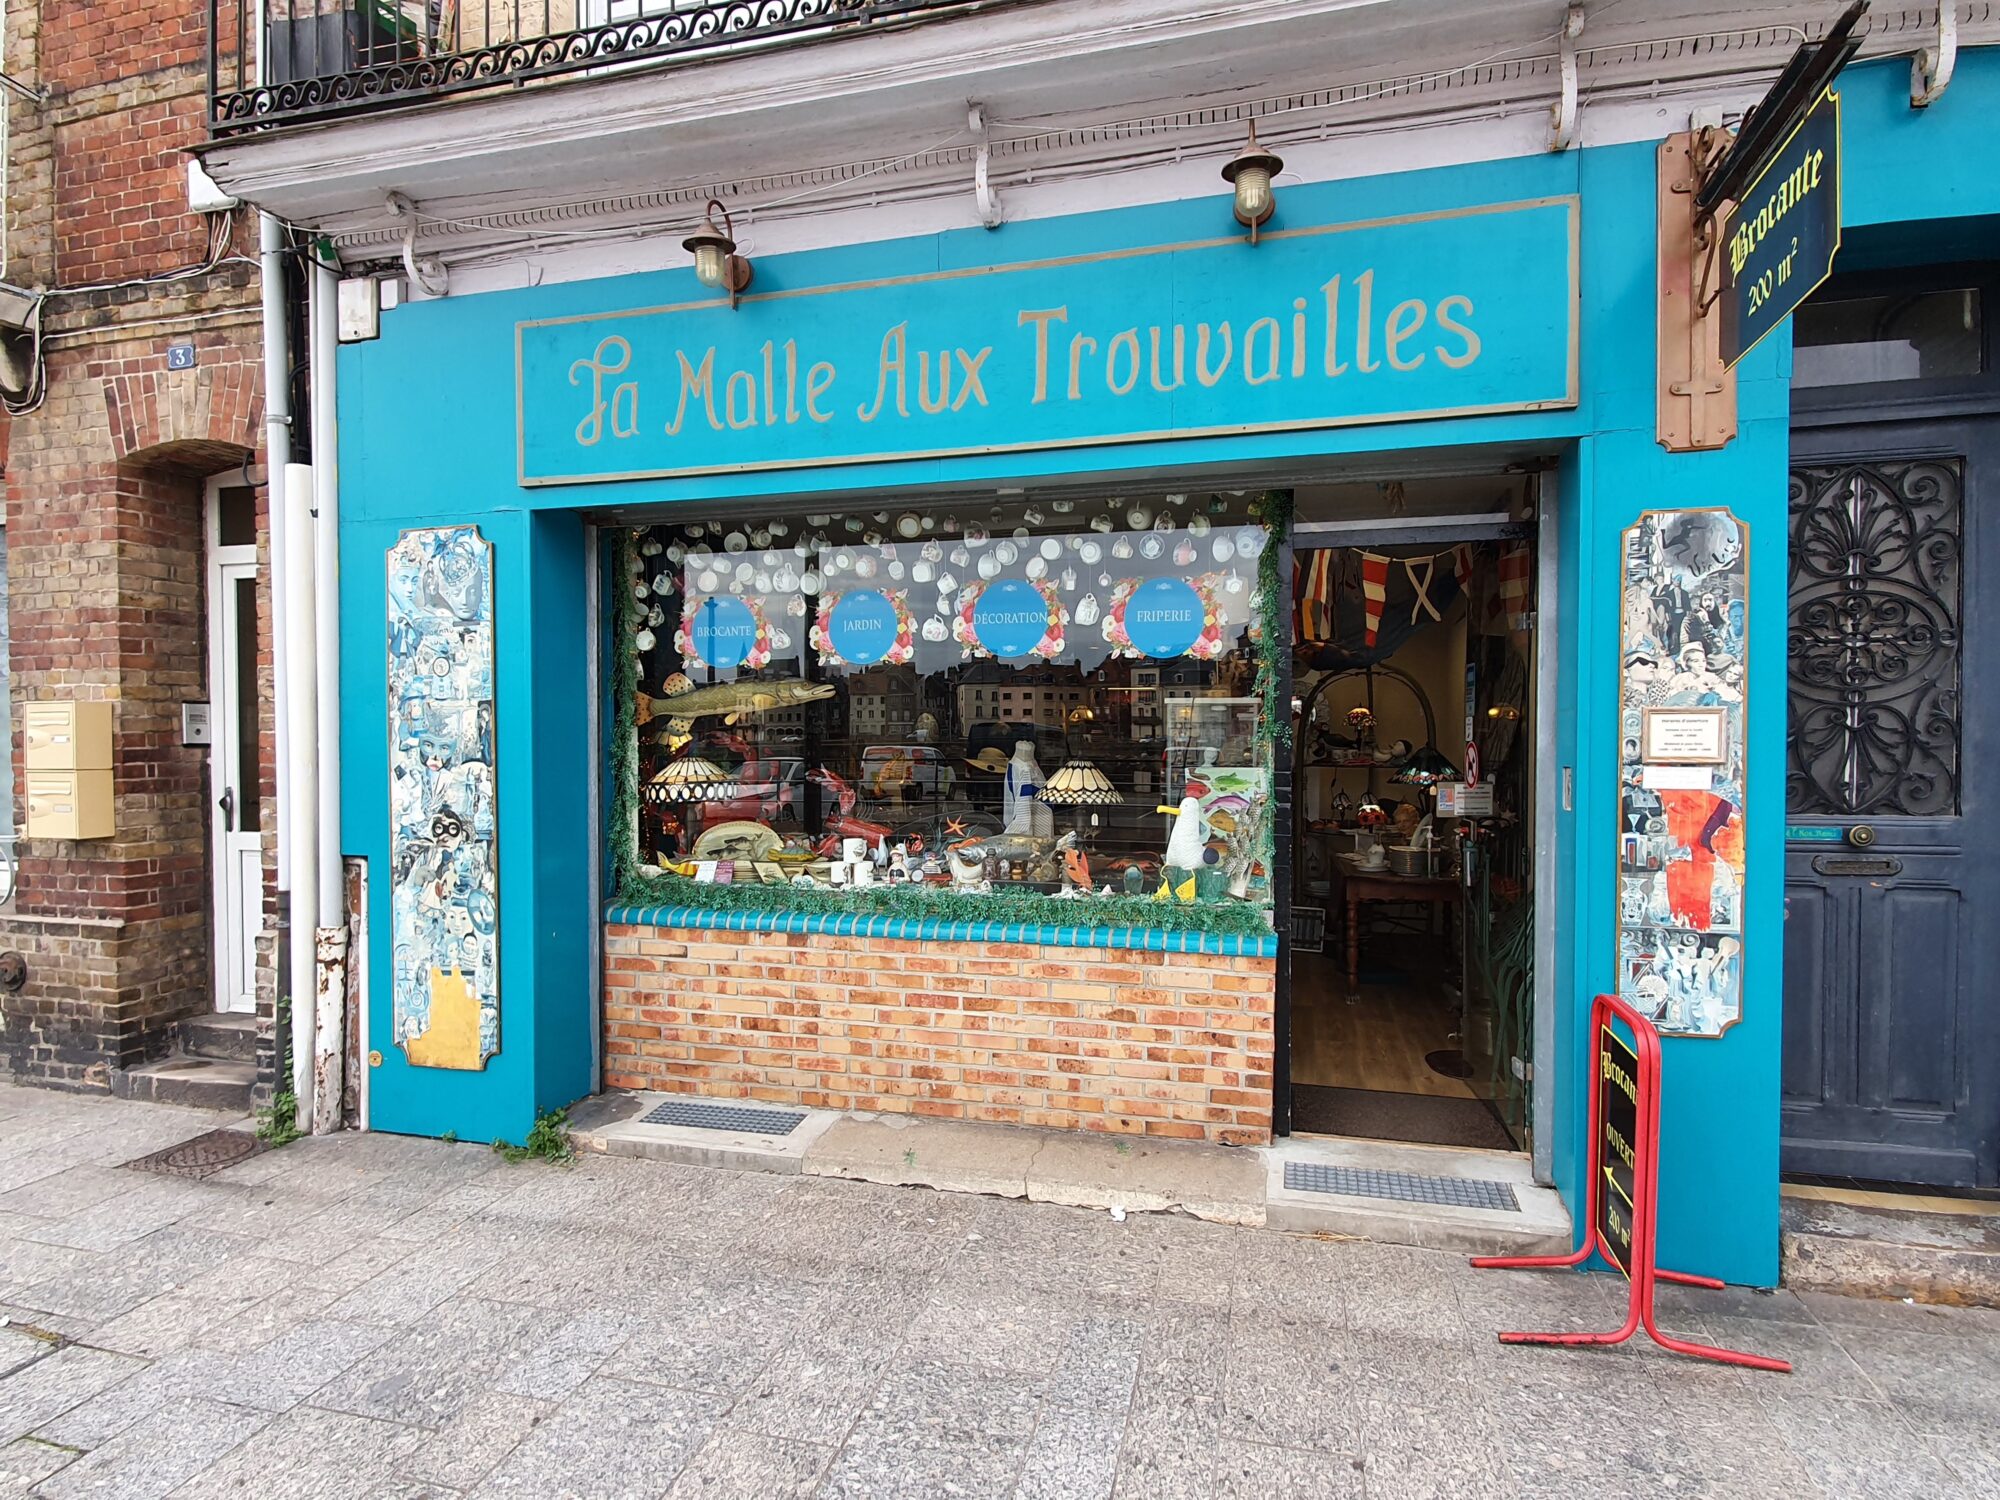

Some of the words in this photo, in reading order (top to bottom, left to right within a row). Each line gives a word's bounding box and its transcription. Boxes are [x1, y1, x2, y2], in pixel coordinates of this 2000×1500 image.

[1729, 148, 1824, 288] Brocante
[1748, 269, 1772, 317] 200
[175, 348, 186, 366] 3
[568, 334, 641, 447] La
[664, 337, 837, 436] Malle
[856, 319, 993, 424] Aux
[1017, 267, 1482, 405] Trouvailles
[696, 624, 752, 638] BROCANTE
[843, 619, 882, 633] JARDIN
[973, 610, 1049, 625] DÉCORATION
[1136, 609, 1192, 623] FRIPERIE
[1602, 1051, 1639, 1106] Brocan
[1606, 1121, 1635, 1171] OUVERT
[1608, 1204, 1620, 1235] 200
